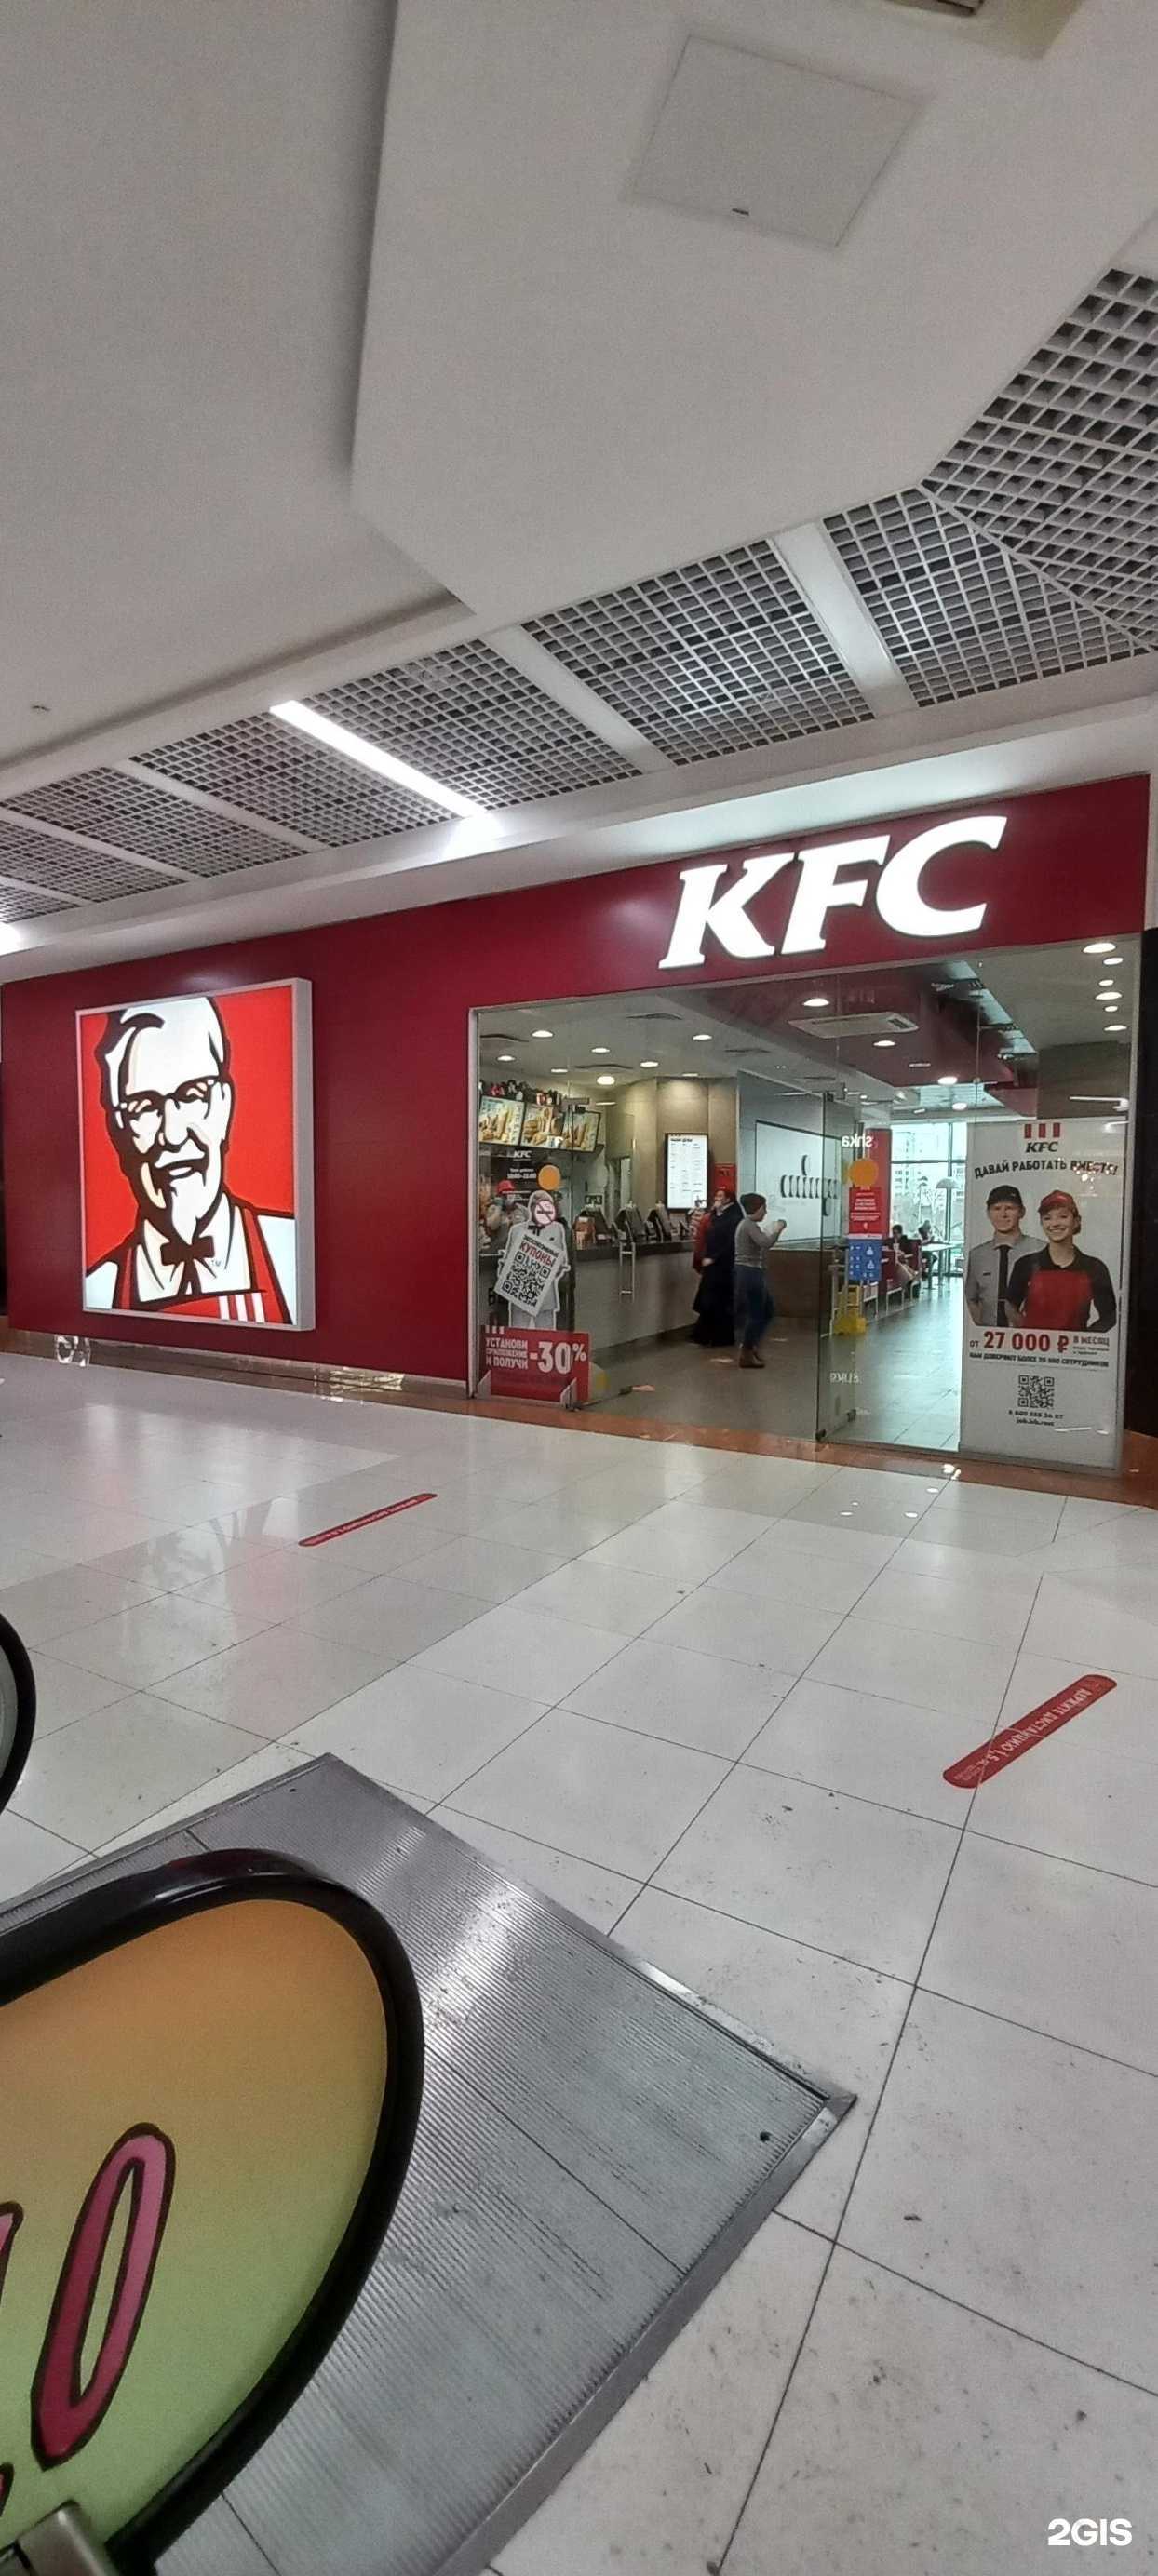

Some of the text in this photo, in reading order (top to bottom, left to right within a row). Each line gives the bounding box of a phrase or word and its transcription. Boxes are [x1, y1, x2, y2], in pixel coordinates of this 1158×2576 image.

[658, 815, 1007, 969] KFC
[1026, 1141, 1059, 1153] KFC
[513, 1150, 532, 1159] KFC
[975, 1160, 1009, 1179] ДАВАЙ
[1012, 1160, 1067, 1172] РАБОТАТЬ
[485, 1337, 528, 1349] УСТАНОВИ
[984, 1331, 1005, 1348] 27
[1012, 1333, 1051, 1352] 000
[1081, 1336, 1110, 1348] МЕСЯЦ
[486, 1356, 529, 1370] И ПОЛУЧИ
[530, 1341, 586, 1375] -30%
